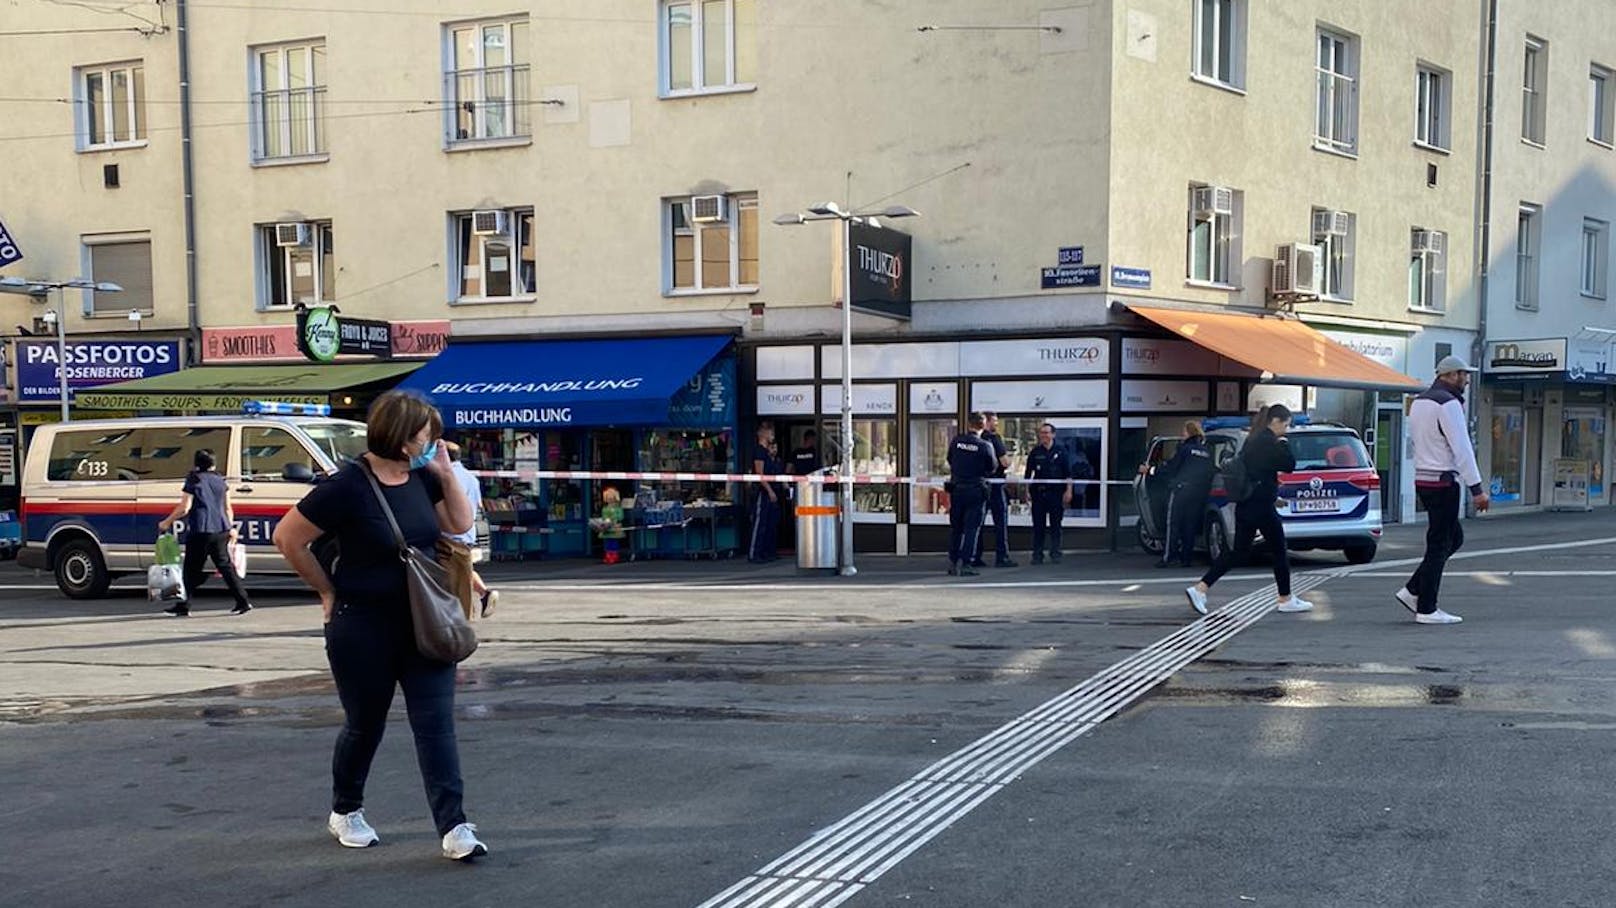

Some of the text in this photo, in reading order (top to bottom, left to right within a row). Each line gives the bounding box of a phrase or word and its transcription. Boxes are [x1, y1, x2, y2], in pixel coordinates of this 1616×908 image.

[857, 244, 901, 280] THURZO
[223, 335, 275, 356] SMOOTHIES
[27, 345, 171, 364] PASSFOTOS
[1036, 347, 1099, 361] THURZO
[55, 367, 144, 379] ROSENBERGER
[431, 378, 643, 394] BUCHHANDLUNG
[83, 396, 150, 408] SMOOTHIES
[161, 397, 202, 409] SOUPS
[455, 408, 572, 425] BUCHHANDLUNG
[88, 461, 109, 477] 133
[1296, 489, 1338, 498] POLIZEI
[173, 520, 271, 541] PZEI
